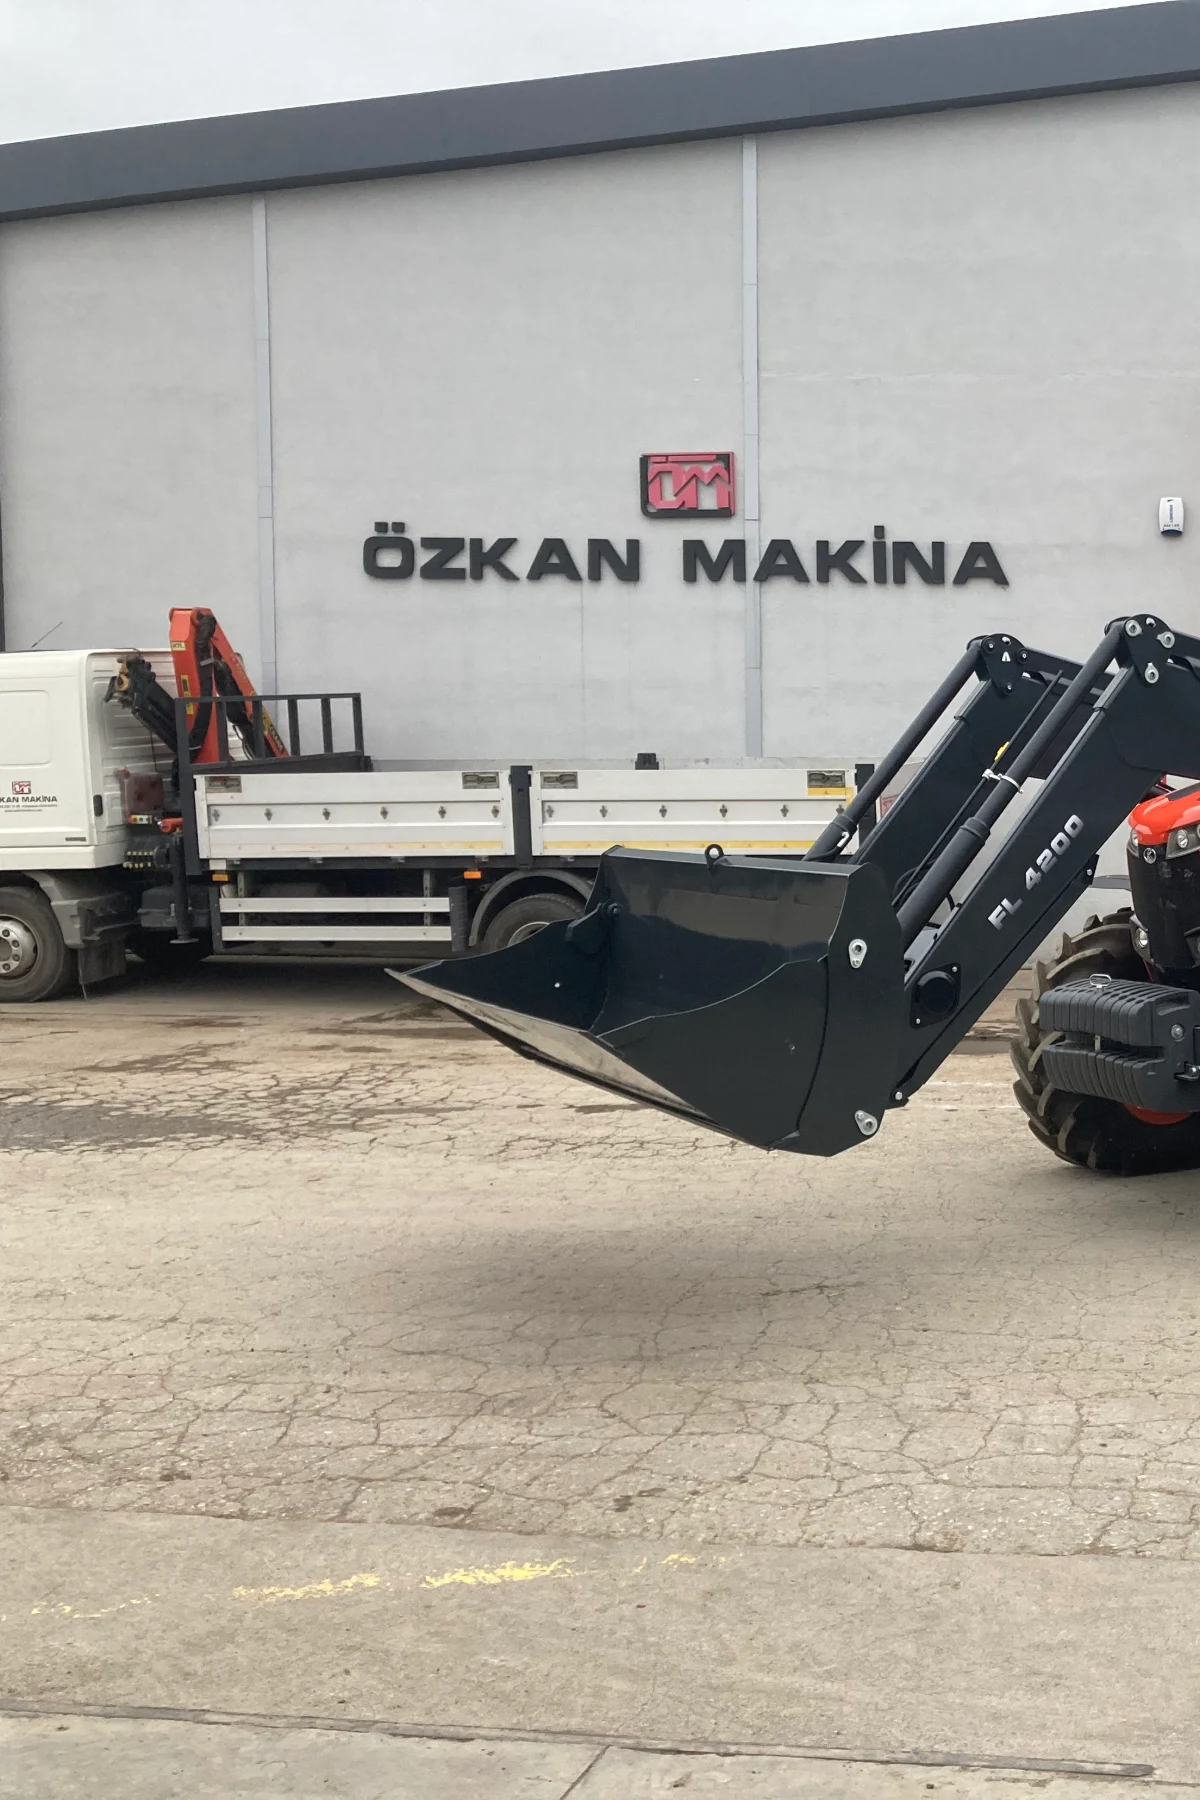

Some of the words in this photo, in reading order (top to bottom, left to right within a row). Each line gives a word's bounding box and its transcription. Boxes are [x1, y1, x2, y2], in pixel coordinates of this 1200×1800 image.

[362, 521, 641, 583] ÖZKAN
[682, 525, 1010, 586] MAKİNA
[22, 795, 57, 803] MAKİNA
[987, 897, 1023, 931] FL
[1025, 814, 1084, 891] 4200
